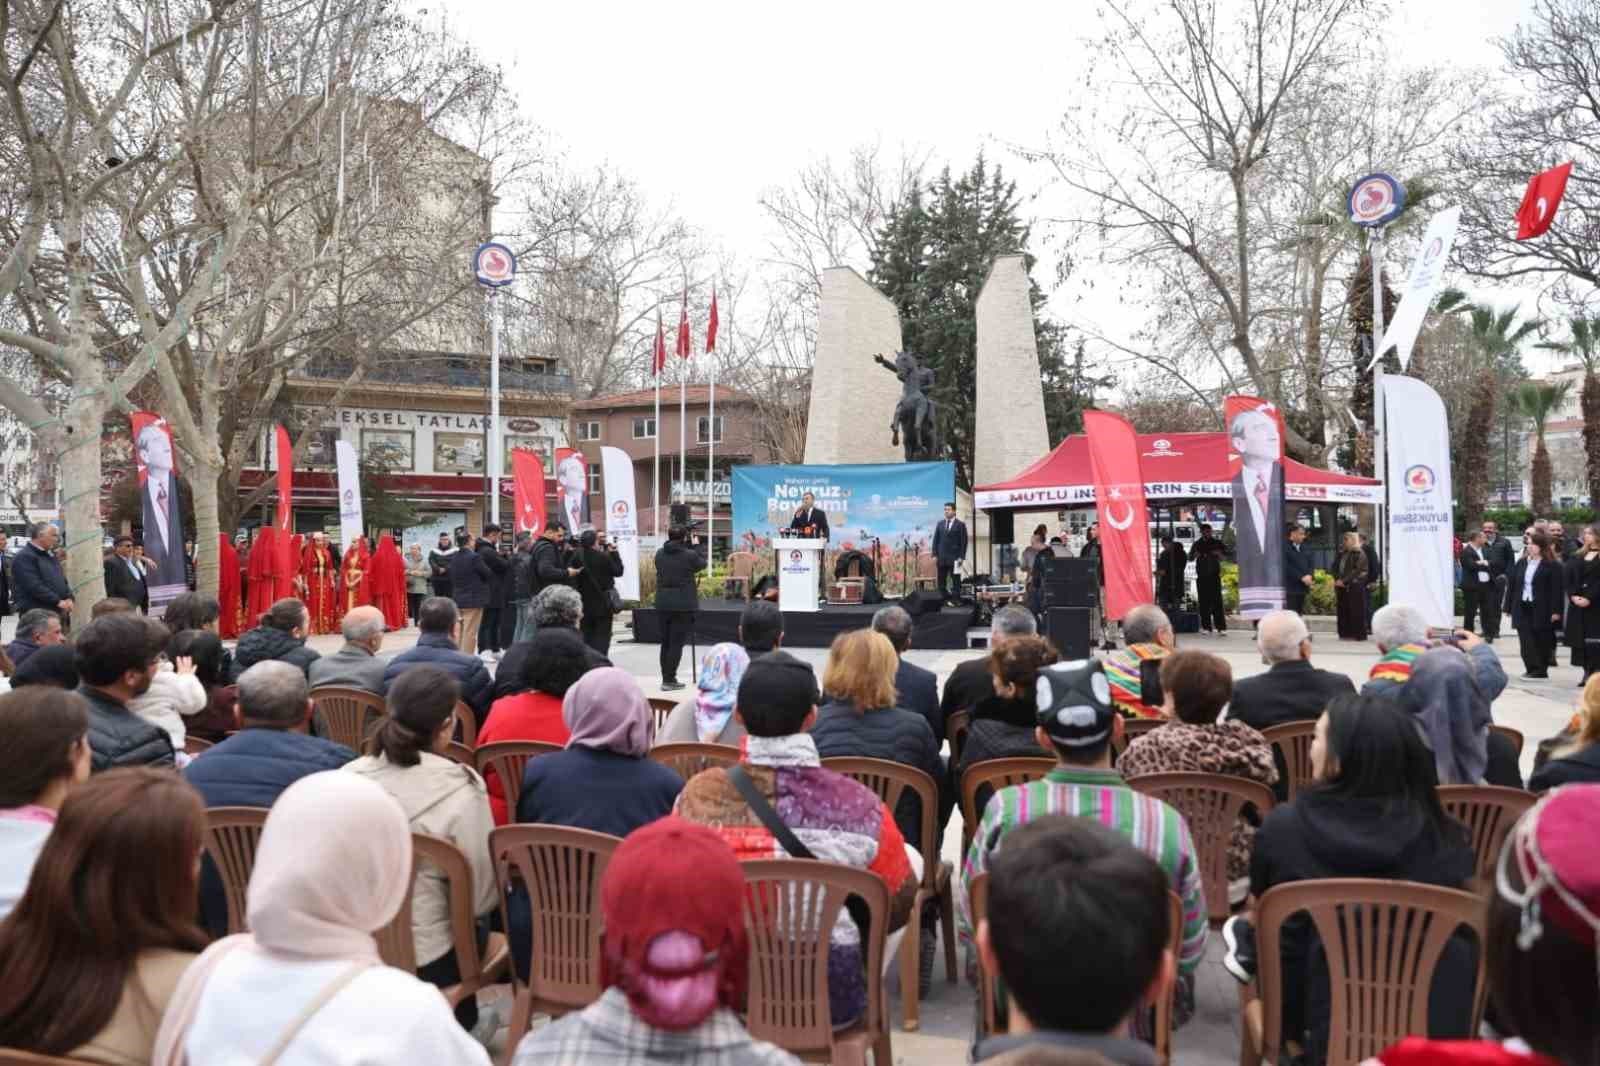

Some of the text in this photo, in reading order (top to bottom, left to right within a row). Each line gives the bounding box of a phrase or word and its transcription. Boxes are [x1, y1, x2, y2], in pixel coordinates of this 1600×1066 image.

[775, 484, 841, 498] Nevruz
[1009, 489, 1067, 502] MUTLU
[1189, 484, 1232, 496] ŞEH
